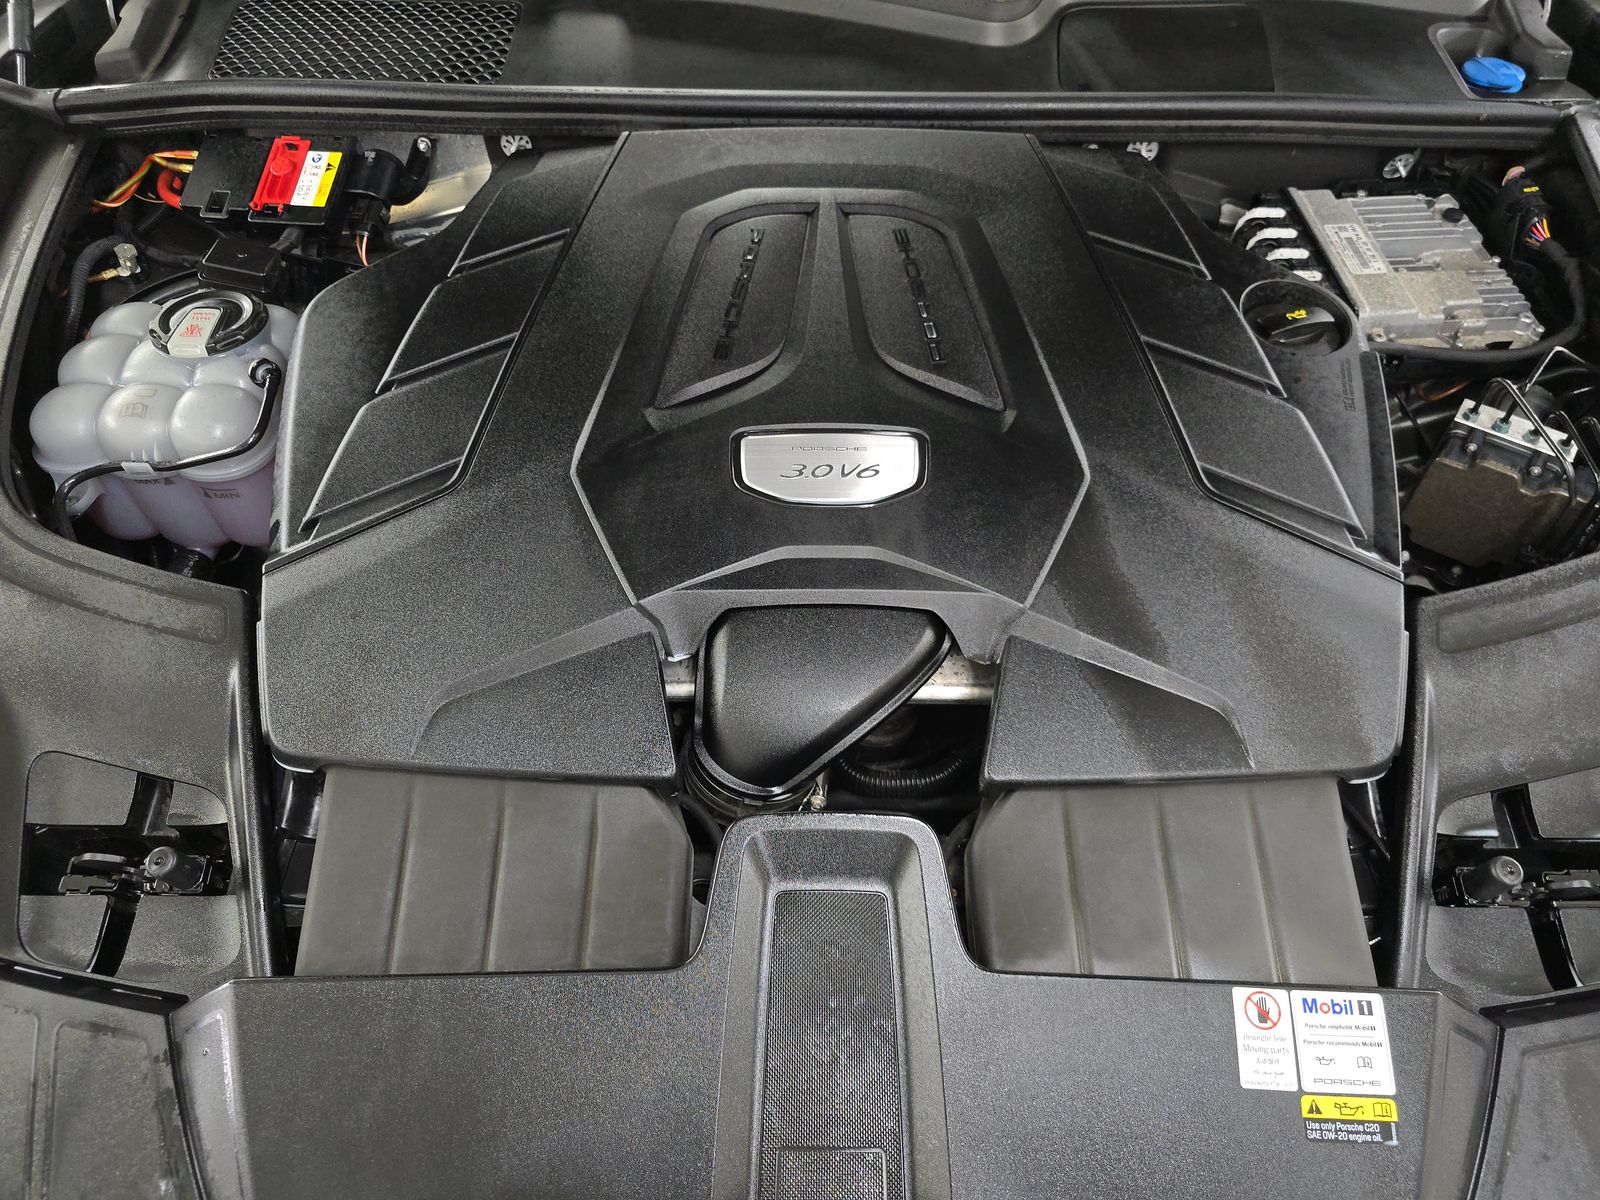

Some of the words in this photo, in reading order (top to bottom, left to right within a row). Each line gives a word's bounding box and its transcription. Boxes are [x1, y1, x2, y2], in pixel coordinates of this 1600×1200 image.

[779, 463, 834, 479] 3.0
[840, 463, 881, 479] V6
[1302, 997, 1354, 1015] Mobil
[1358, 1000, 1372, 1016] 1
[1243, 1044, 1269, 1055] Moving
[1270, 1047, 1290, 1055] parts
[1313, 1078, 1382, 1087] PORSCHE
[1306, 1121, 1319, 1130] Use
[1320, 1121, 1336, 1132] only
[1336, 1122, 1364, 1132] Porsche
[1364, 1123, 1380, 1133] C20
[1307, 1130, 1321, 1139] SAE
[1322, 1131, 1348, 1141] 0W-20
[1348, 1133, 1372, 1143] engine
[1372, 1134, 1384, 1142] oil.
